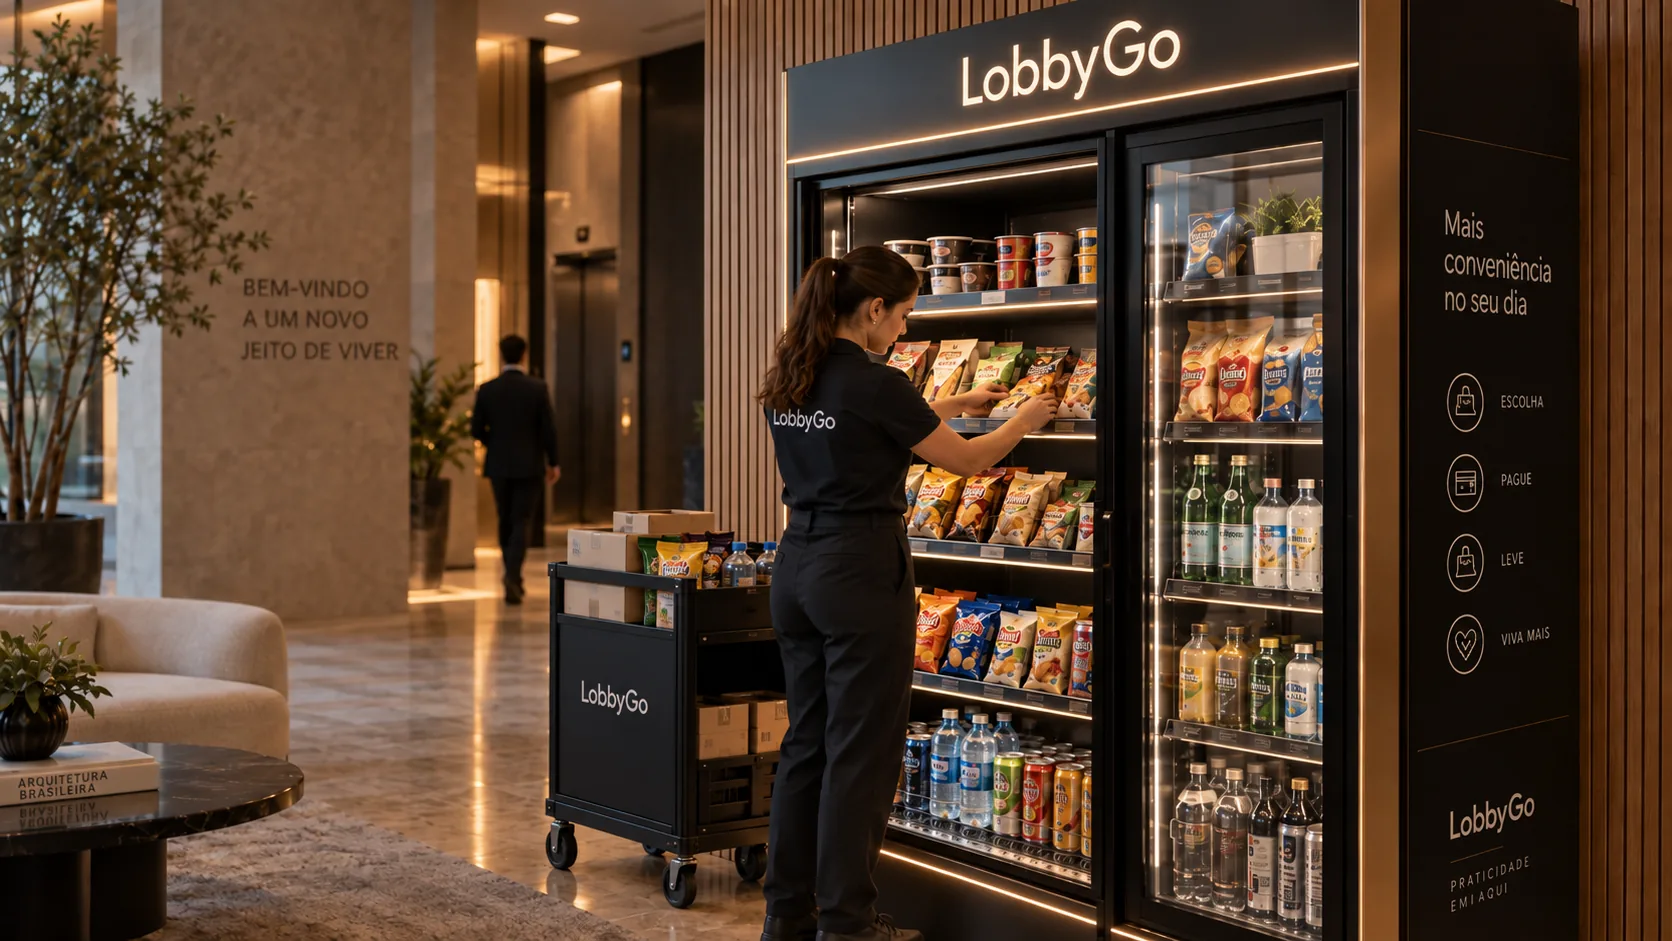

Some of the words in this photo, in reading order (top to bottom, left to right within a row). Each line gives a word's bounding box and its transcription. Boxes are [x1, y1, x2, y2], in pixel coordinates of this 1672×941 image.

[962, 19, 1181, 107] LobbyGo
[1444, 208, 1484, 240] Mais
[1444, 252, 1552, 284] conveniência
[243, 278, 369, 299] BEM-VINDO
[1444, 291, 1466, 312] no
[1470, 293, 1499, 314] seu
[1503, 288, 1527, 316] dia
[242, 308, 258, 329] A
[264, 309, 299, 329] UM
[305, 309, 369, 330] NOVO
[240, 340, 298, 361] JEITO
[304, 341, 332, 361] DE
[338, 341, 399, 361] VIVER
[1501, 394, 1544, 409] ESCOLHA
[773, 408, 836, 433] LobbyGo
[1501, 472, 1532, 487] PAGUE
[1501, 551, 1524, 567] LEVE
[1501, 631, 1524, 646] VIVA
[1527, 626, 1550, 642] MAIS
[581, 679, 649, 716] LobbyGo
[18, 770, 108, 788] ARQUITETURA
[19, 783, 96, 800] BRASILEIRA
[1450, 792, 1535, 840] LobbyGo
[1450, 855, 1530, 893] PRATICIDADE
